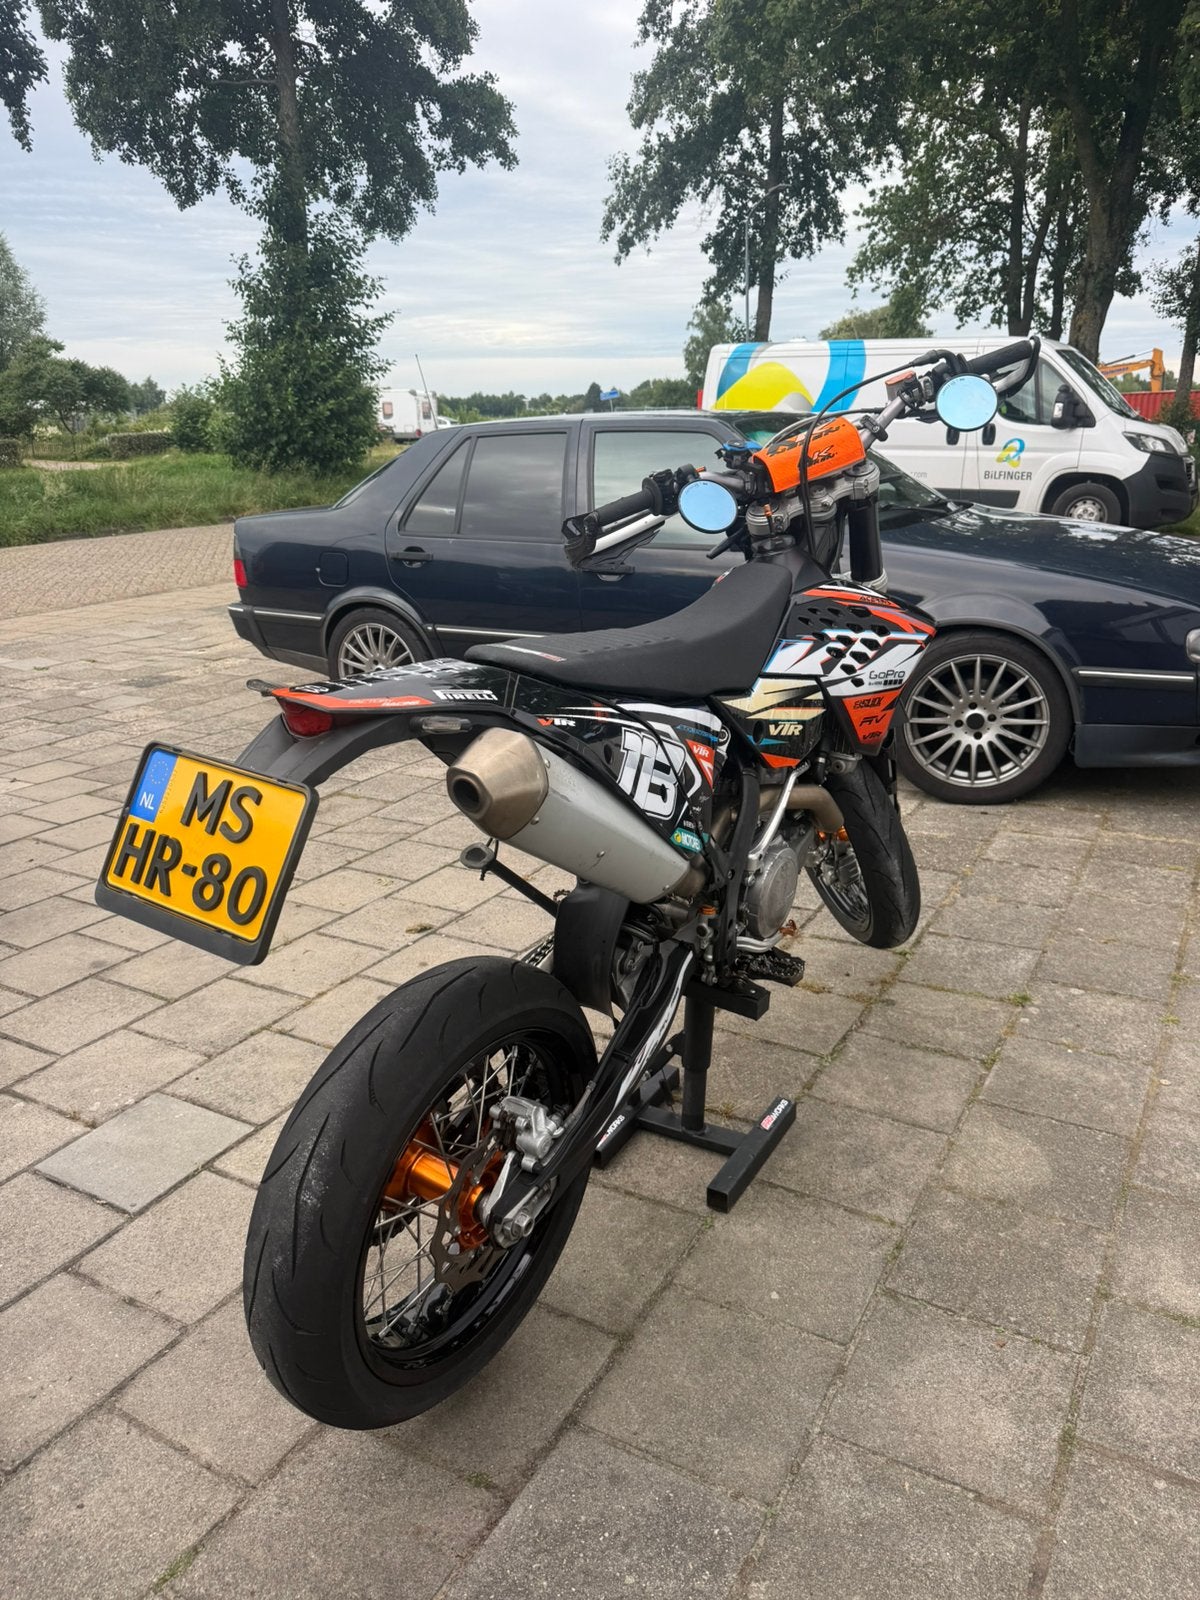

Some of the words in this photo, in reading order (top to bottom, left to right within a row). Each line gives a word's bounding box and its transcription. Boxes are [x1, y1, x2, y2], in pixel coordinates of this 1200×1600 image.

[869, 669, 906, 680] GoPro
[432, 689, 498, 701] PIRELLI
[139, 791, 154, 810] NL
[180, 771, 263, 844] MS
[113, 823, 268, 926] HR-80
